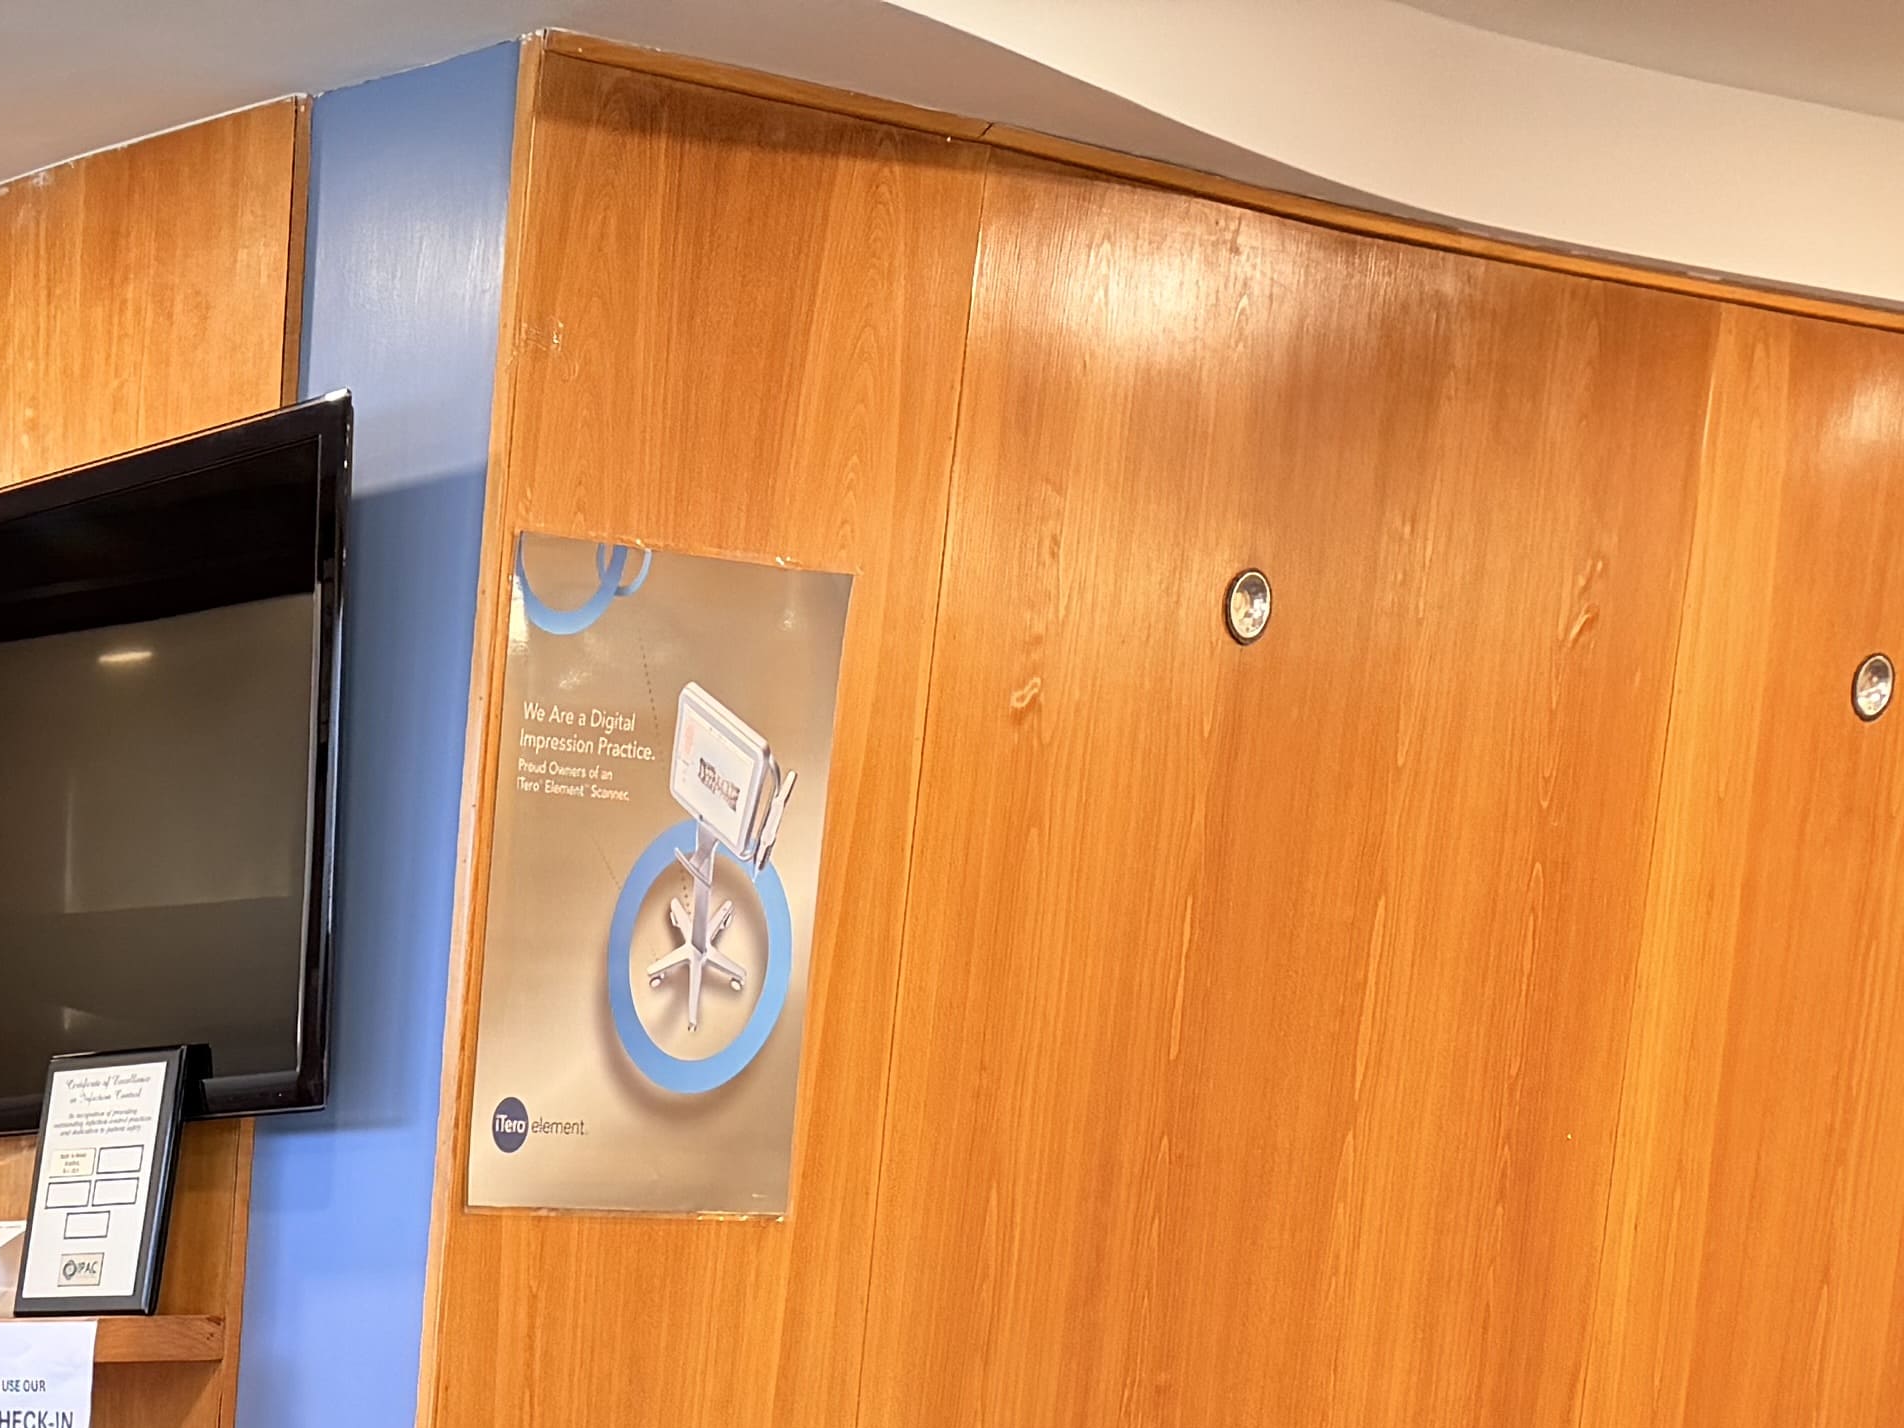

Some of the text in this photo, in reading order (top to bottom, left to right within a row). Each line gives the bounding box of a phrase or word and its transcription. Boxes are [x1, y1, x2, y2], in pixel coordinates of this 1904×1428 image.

[523, 701, 636, 734] We Are a Digital
[519, 728, 656, 761] Impression Practice.
[518, 758, 613, 780] Proud Owners of an
[495, 1114, 585, 1136] iTero element
[2, 1380, 20, 1392] USE
[23, 1380, 46, 1392] OUR
